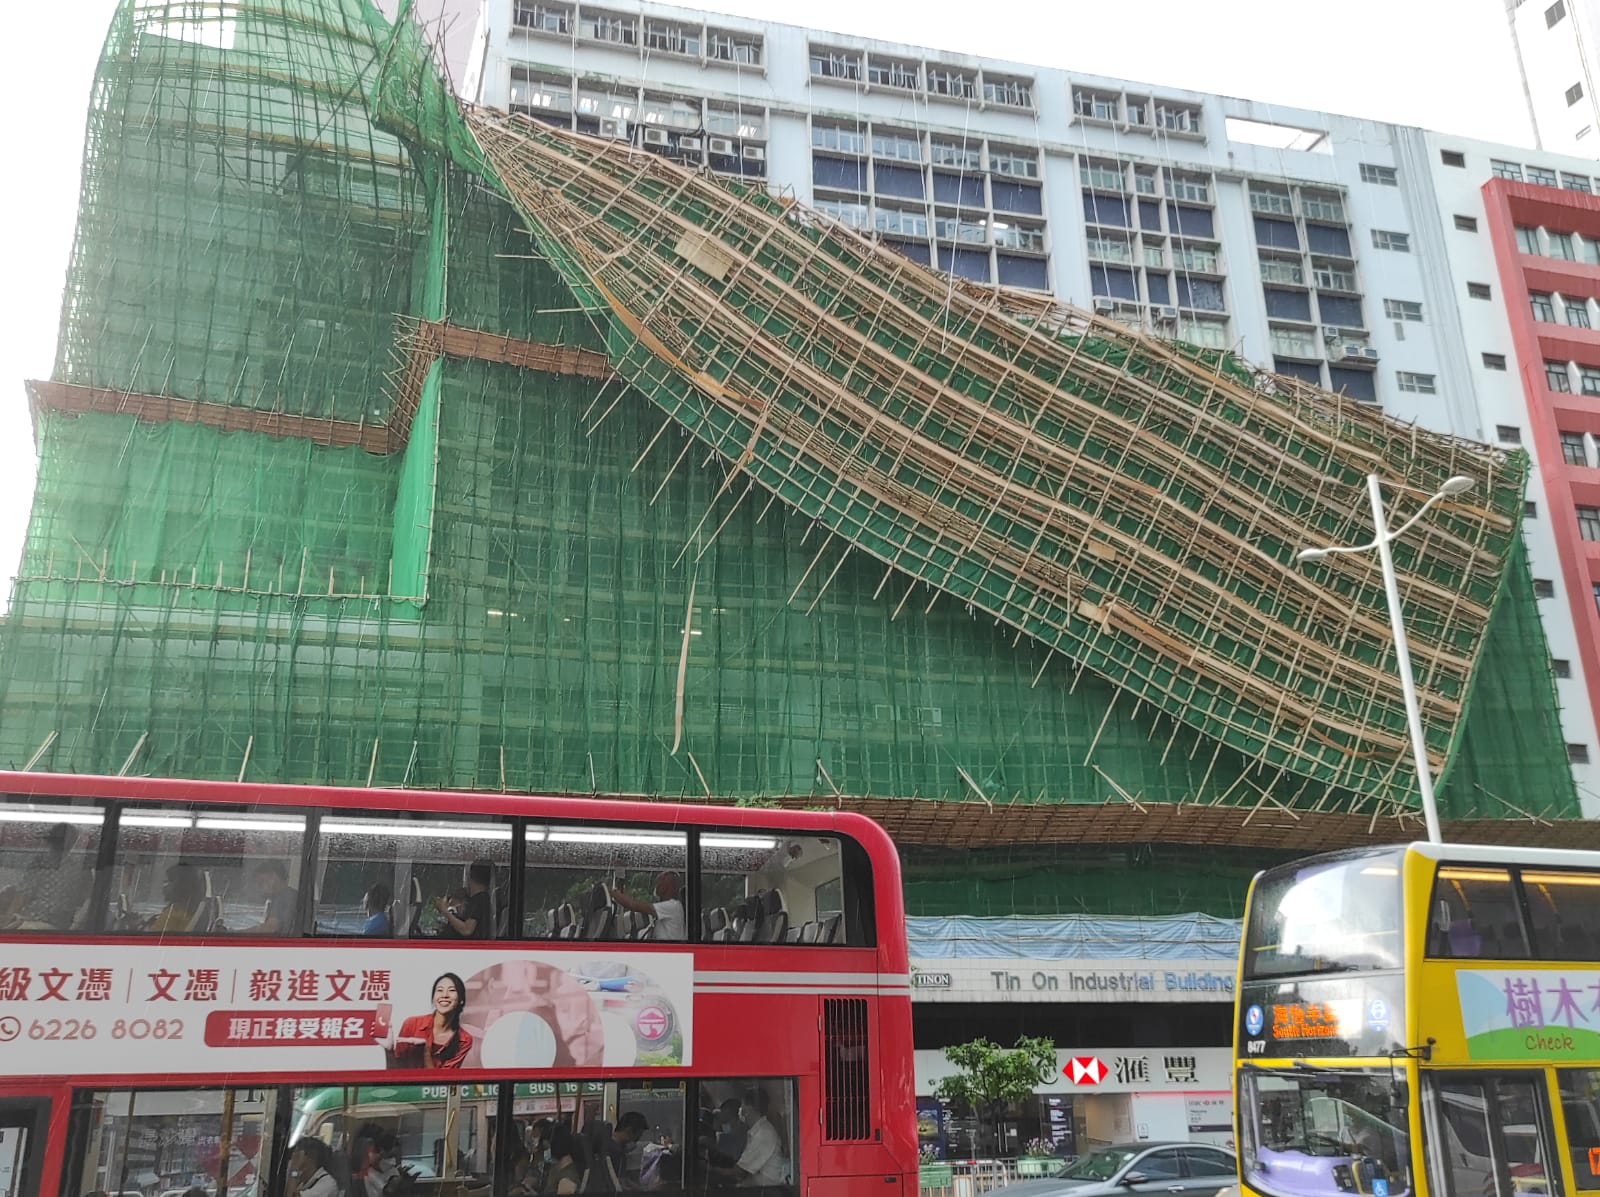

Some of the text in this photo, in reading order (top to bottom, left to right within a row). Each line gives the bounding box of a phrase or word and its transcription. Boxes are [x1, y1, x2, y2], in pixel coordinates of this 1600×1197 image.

[0, 967, 391, 1002] 級文憑 文憑 毅進文憑
[990, 971, 1235, 993] Tin On Industrial Building
[28, 1018, 184, 1040] 6226 8082
[227, 1017, 365, 1040] 現正接受報名
[1272, 1024, 1300, 1038] South
[1525, 1033, 1575, 1050] Check
[529, 1082, 555, 1094] BUS
